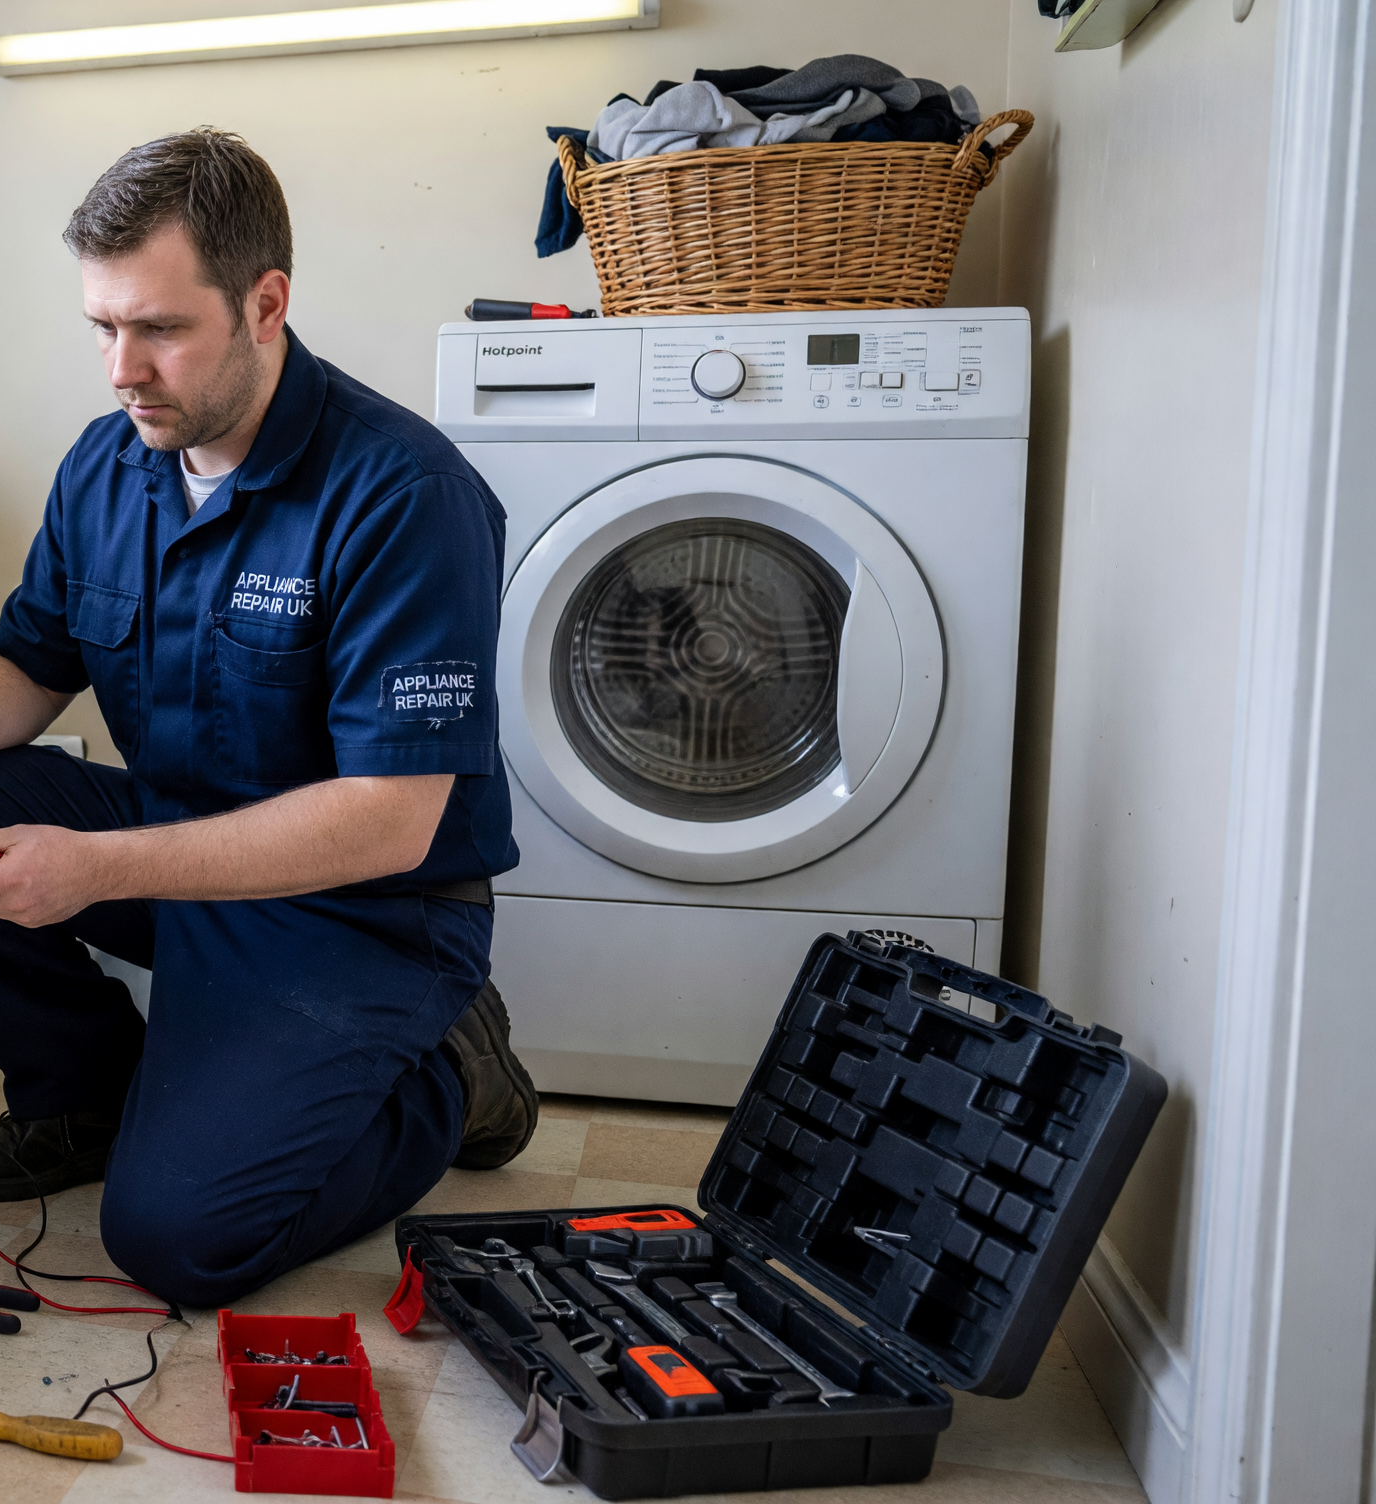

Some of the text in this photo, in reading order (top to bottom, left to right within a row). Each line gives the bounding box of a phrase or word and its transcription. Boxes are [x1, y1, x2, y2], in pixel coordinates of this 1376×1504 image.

[482, 344, 543, 358] Hotpoint
[230, 592, 313, 616] REPAIR UK
[392, 674, 475, 693] APPLIANCE
[395, 691, 474, 711] REPAIR UK
